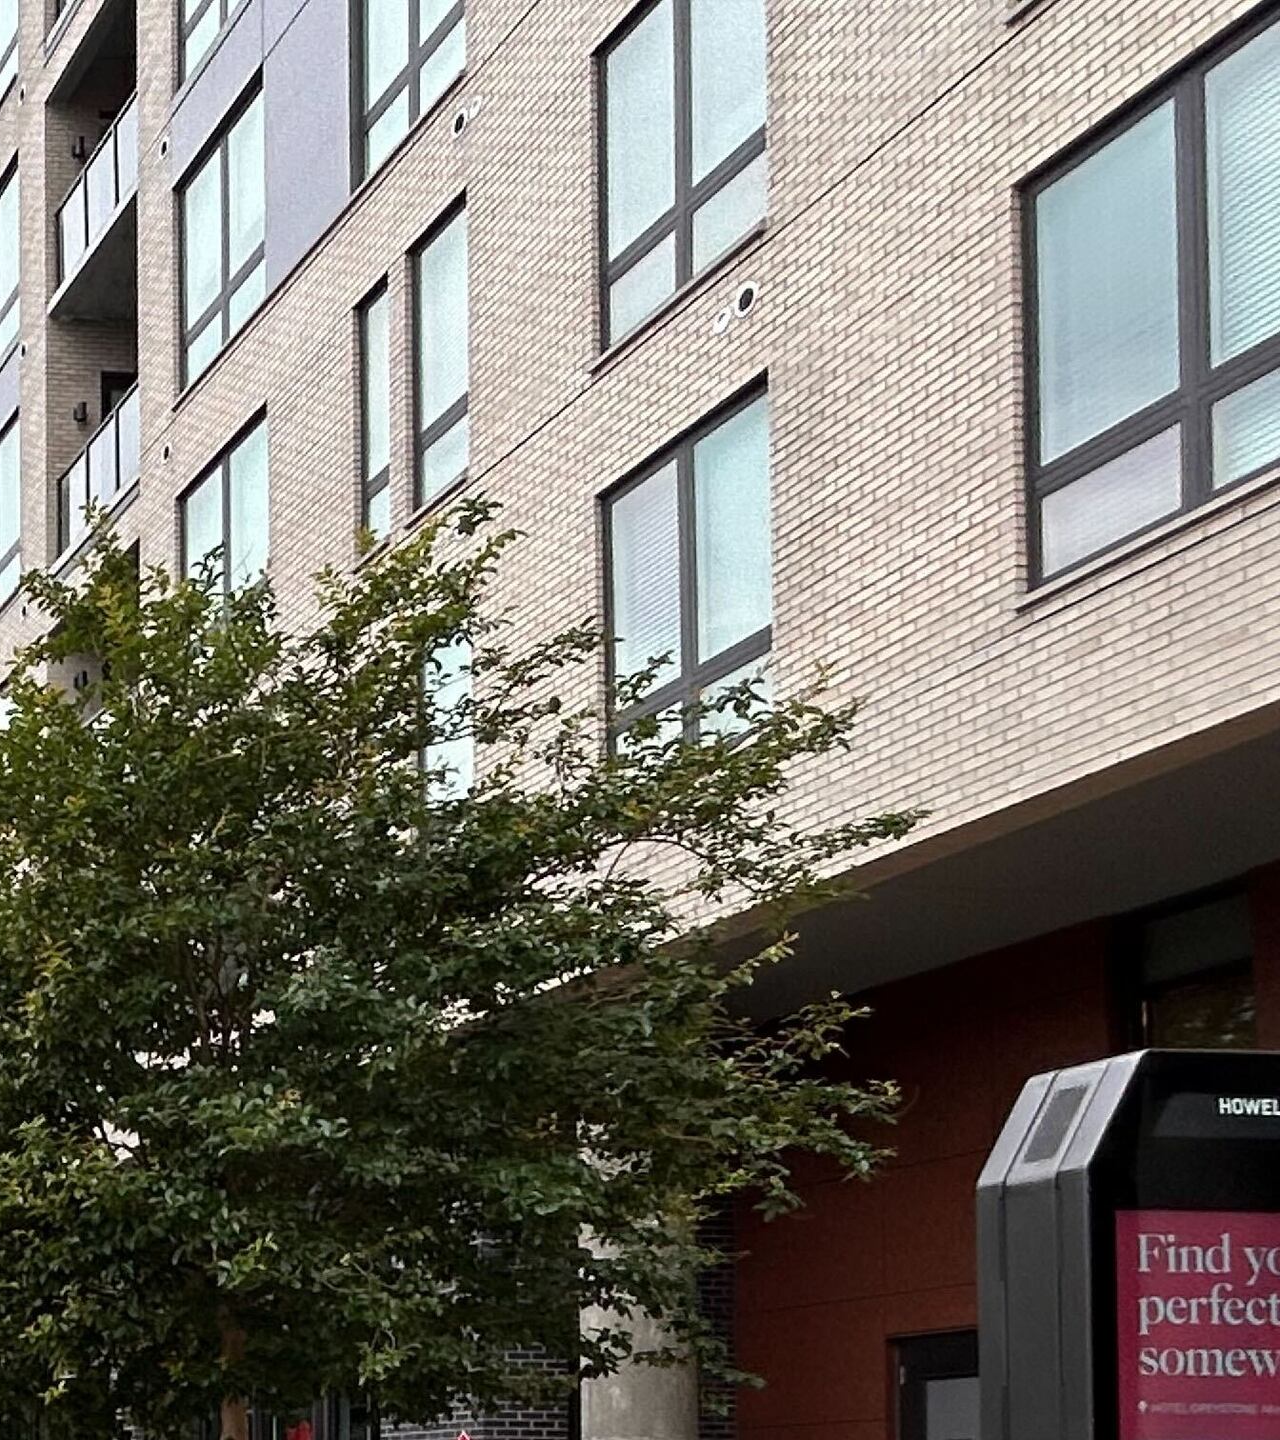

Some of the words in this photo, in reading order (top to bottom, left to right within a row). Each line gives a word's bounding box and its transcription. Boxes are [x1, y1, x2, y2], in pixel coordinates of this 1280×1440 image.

[1218, 1097, 1280, 1116] HOWEL
[1138, 1233, 1231, 1273] Find
[1138, 1282, 1280, 1335] perfect
